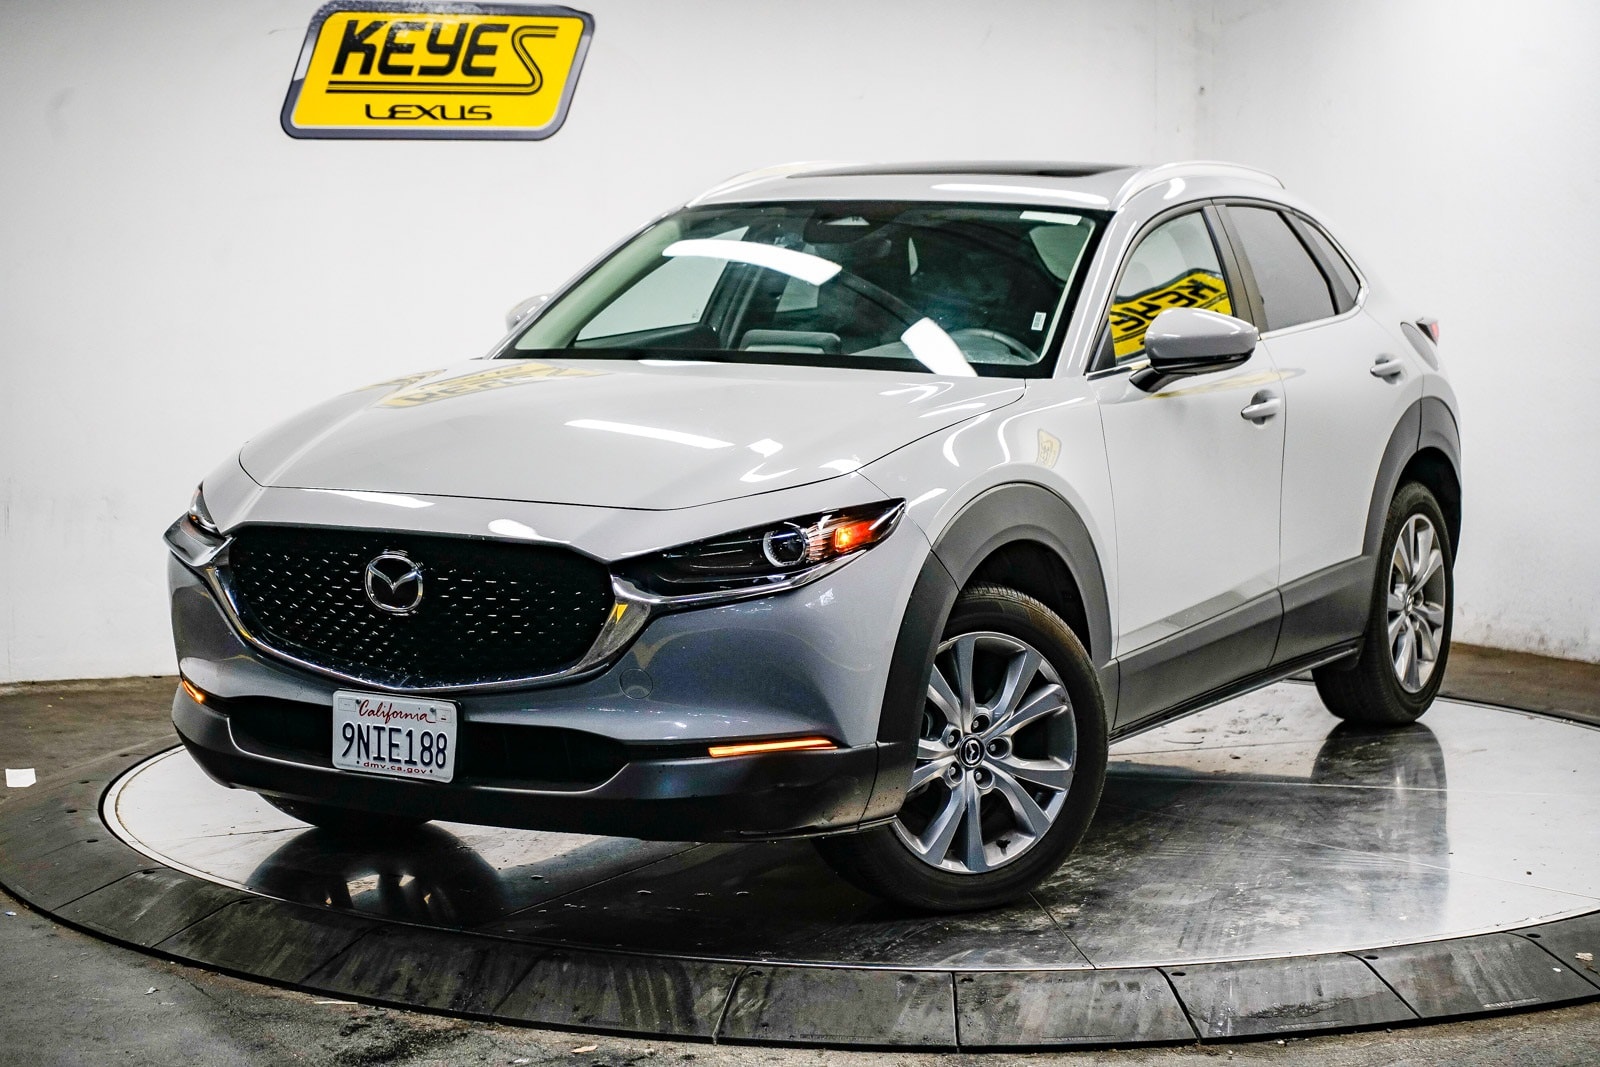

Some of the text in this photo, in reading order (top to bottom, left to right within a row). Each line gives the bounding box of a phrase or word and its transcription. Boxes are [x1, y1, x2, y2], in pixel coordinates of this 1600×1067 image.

[326, 20, 559, 95] KEYES
[365, 104, 493, 120] LEXUS
[359, 699, 436, 724] California
[342, 723, 447, 769] 9NIE188
[363, 761, 427, 774] dmv.ca.gov
